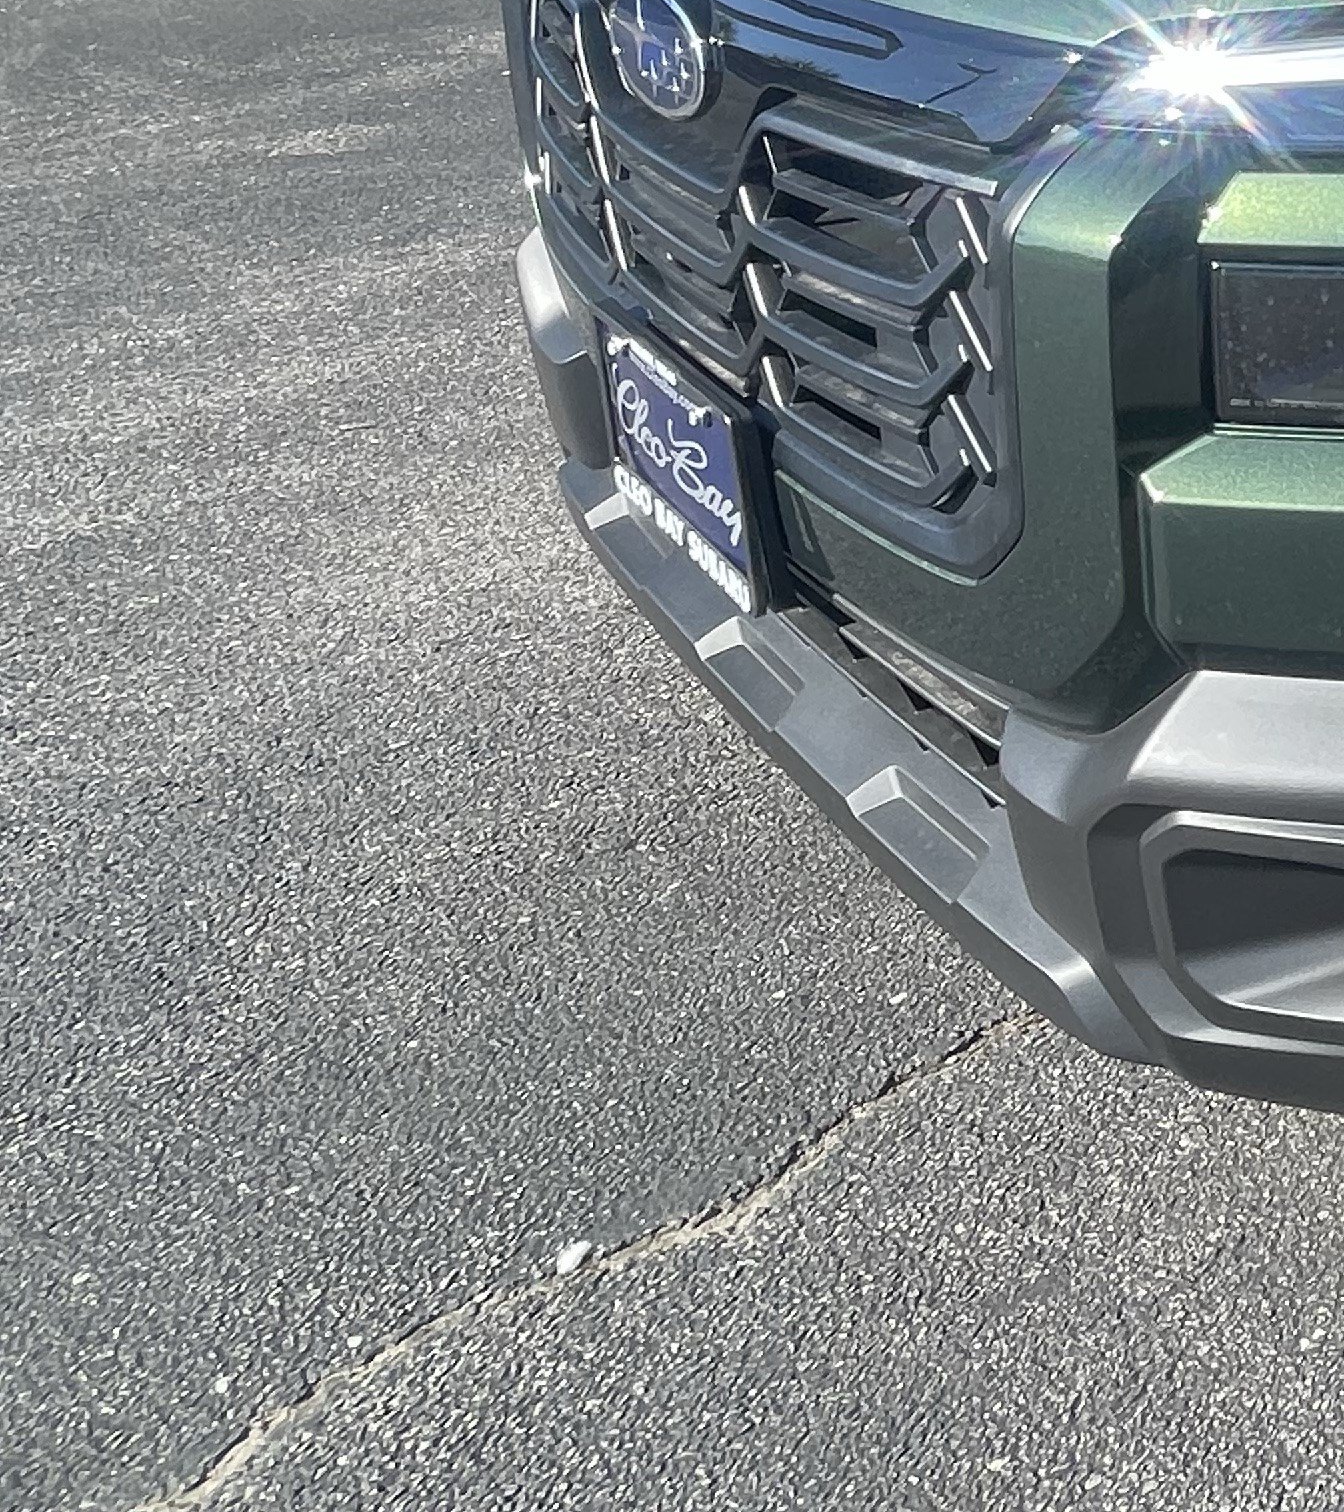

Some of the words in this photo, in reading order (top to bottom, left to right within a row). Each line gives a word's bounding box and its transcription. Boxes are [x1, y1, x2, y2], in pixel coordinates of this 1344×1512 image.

[613, 464, 653, 516] CLEO
[654, 498, 686, 547] BAY
[687, 530, 751, 614] SUBARU
[615, 378, 672, 468] Cleo
[667, 418, 743, 547] Bay
